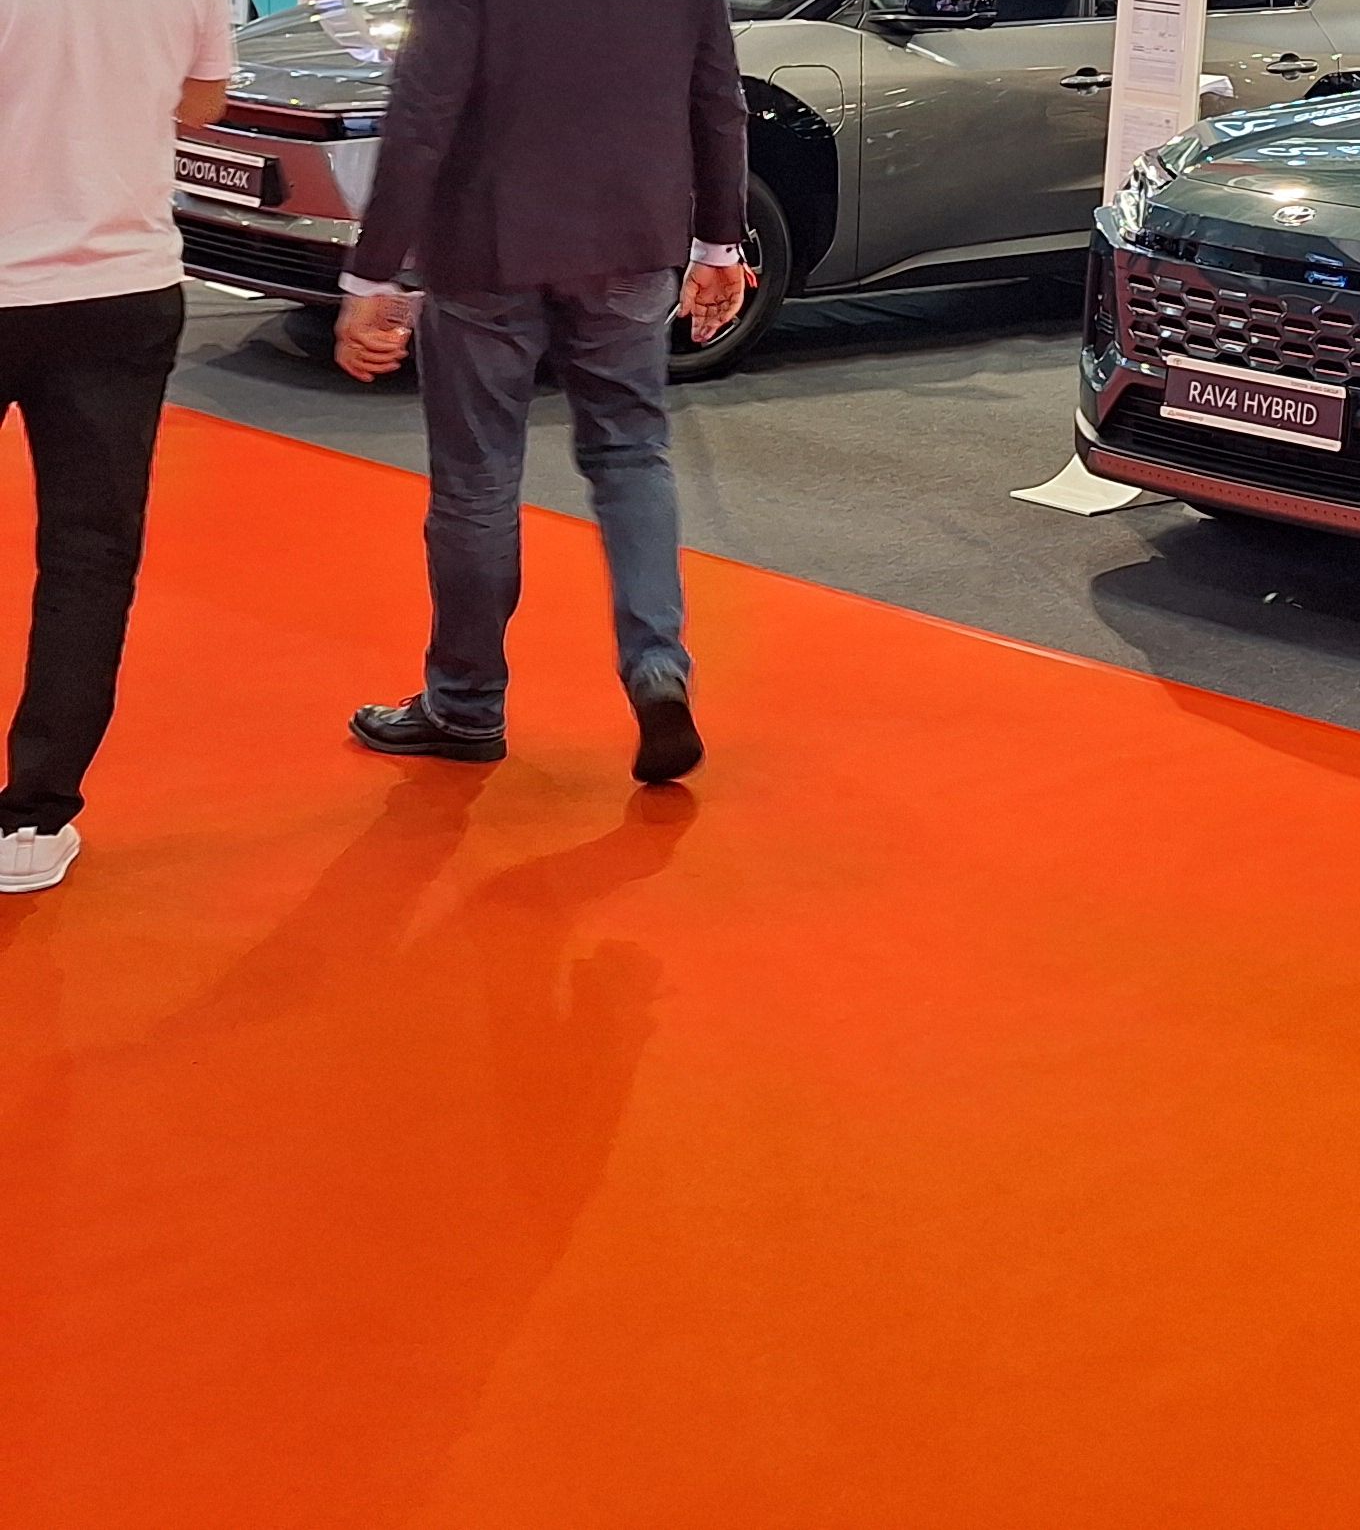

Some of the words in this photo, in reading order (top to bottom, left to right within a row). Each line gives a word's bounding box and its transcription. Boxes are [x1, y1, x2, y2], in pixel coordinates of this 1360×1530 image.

[176, 157, 217, 181] TOYOTA
[219, 167, 249, 188] bZ4X
[1189, 381, 1237, 410] RAV4
[1243, 391, 1317, 425] HYBRID
